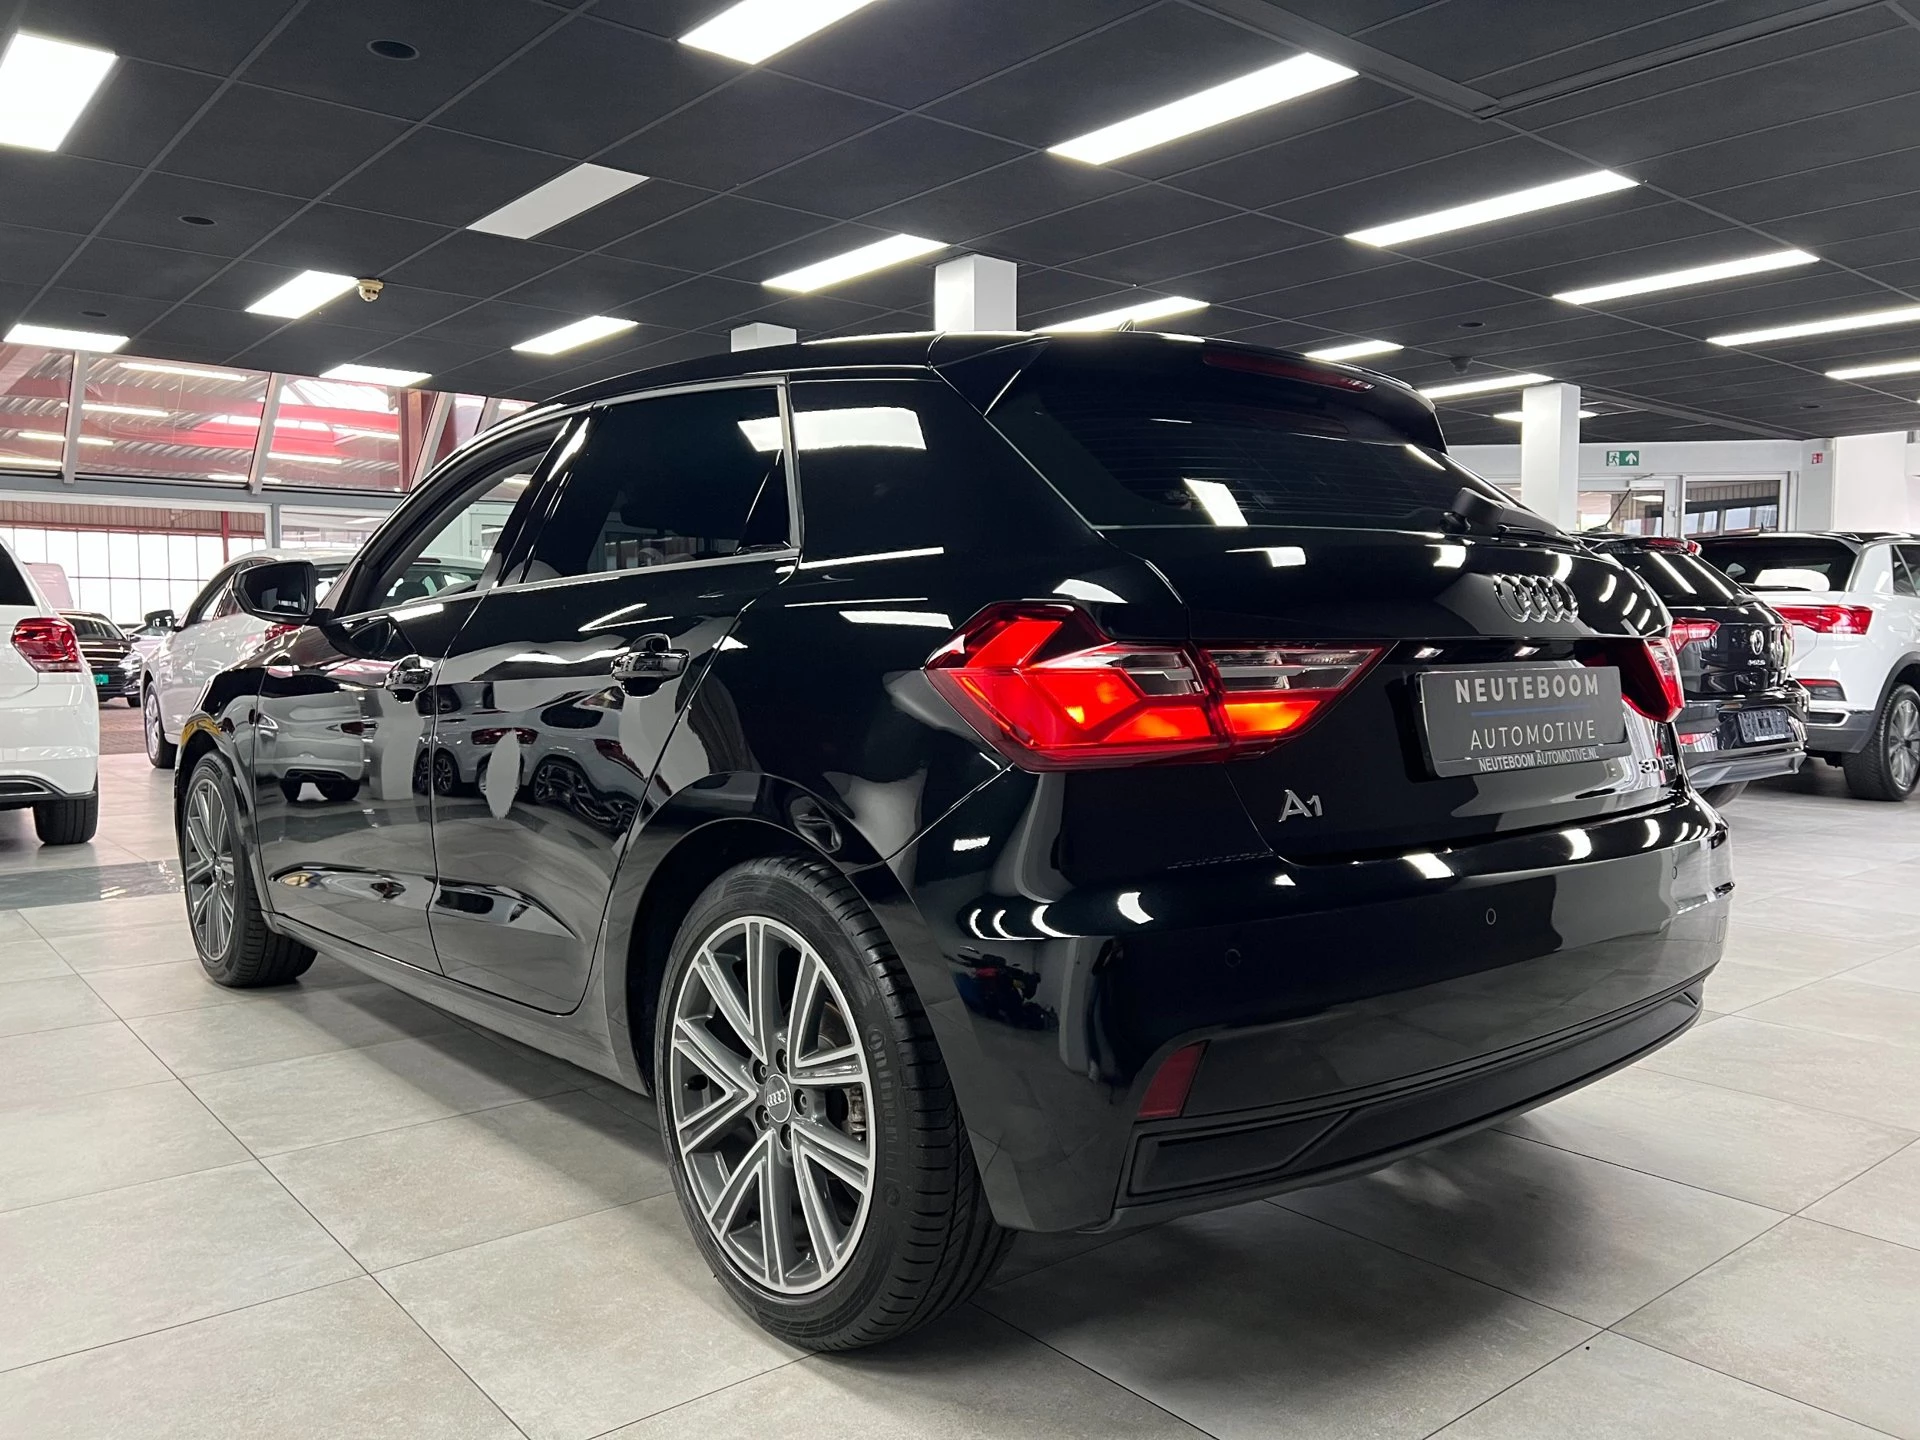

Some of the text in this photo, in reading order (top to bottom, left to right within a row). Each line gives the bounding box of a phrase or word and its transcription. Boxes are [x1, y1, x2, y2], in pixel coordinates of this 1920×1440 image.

[1455, 673, 1599, 704] NEUTEBOOM
[1470, 719, 1596, 751] AUTOMOTIVE
[1278, 789, 1323, 823] A1
